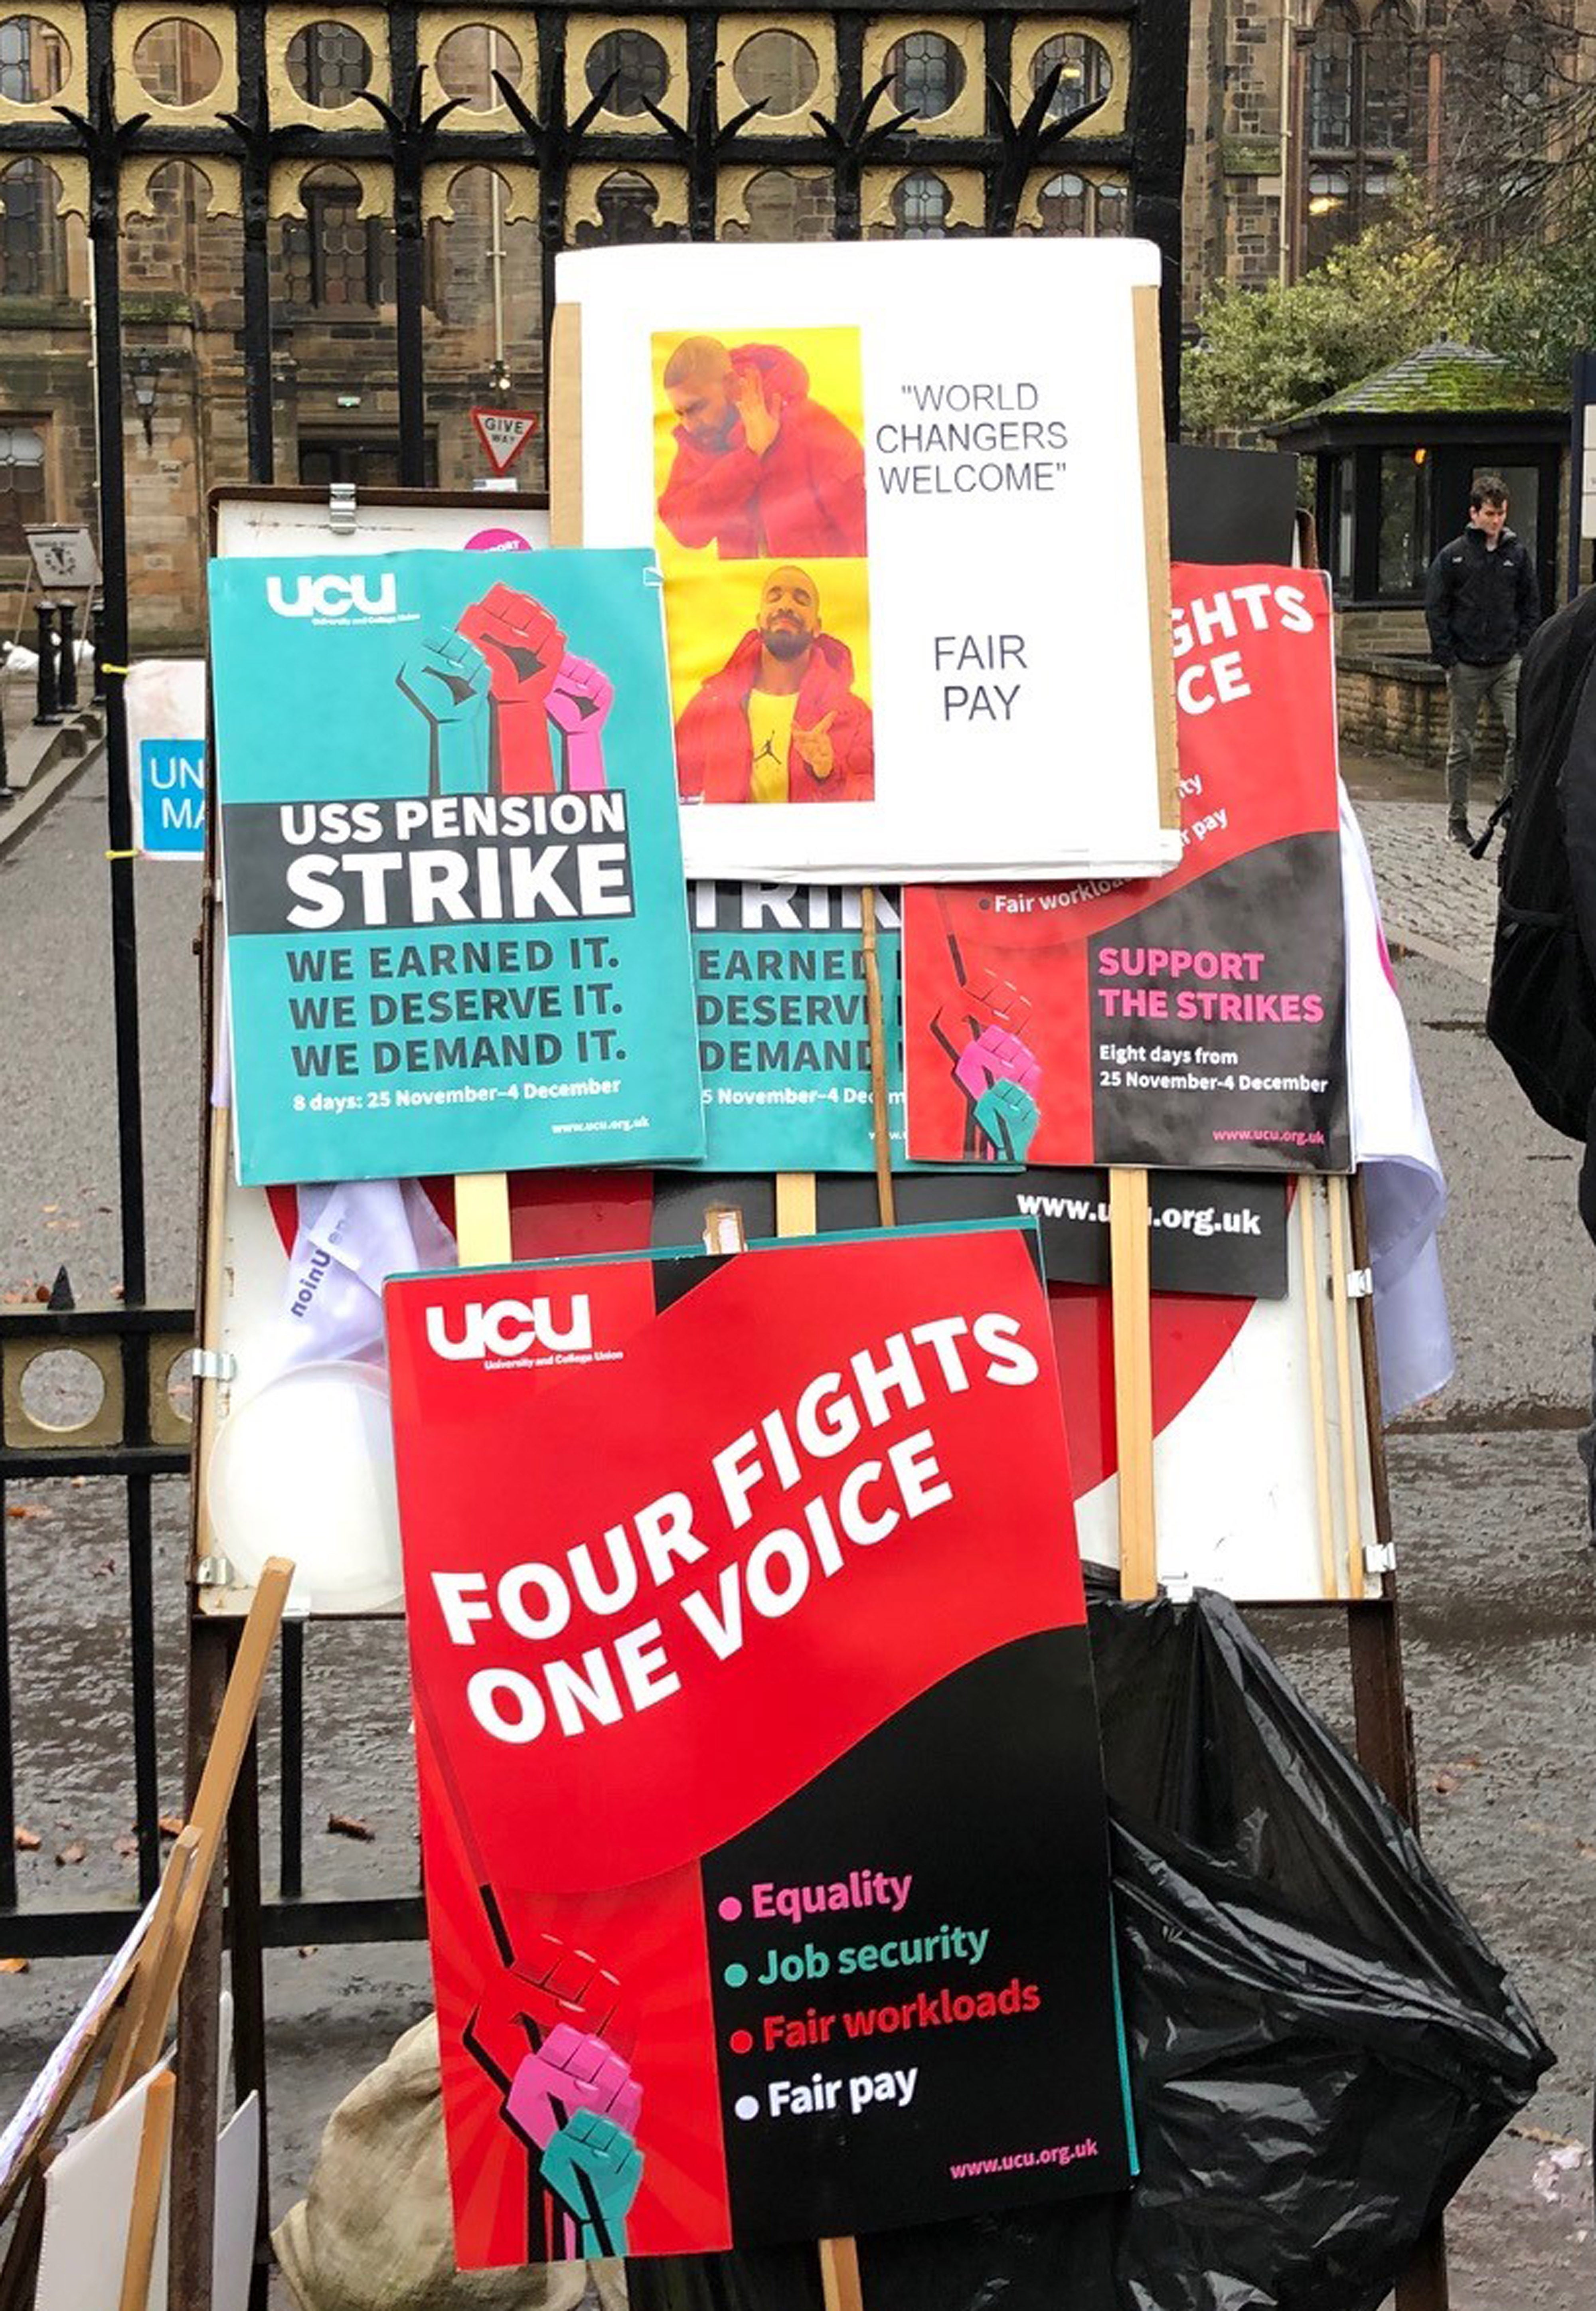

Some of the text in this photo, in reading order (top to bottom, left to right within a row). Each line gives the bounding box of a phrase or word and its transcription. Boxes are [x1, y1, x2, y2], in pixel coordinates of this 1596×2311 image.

[901, 382, 1038, 412] "WORLD
[485, 417, 524, 435] GIVE
[492, 434, 515, 442] WAY
[876, 422, 1068, 454] CHANGERS
[879, 462, 1067, 494] WELCOME"
[934, 634, 1028, 671] FAIR
[943, 685, 1020, 721] PAY
[280, 793, 625, 845] USS PENSION
[1192, 808, 1227, 840] pay
[286, 843, 632, 928] STRIKE
[995, 878, 1132, 913] Fair workloa
[286, 937, 618, 982] WE EARNED IT.
[1098, 948, 1264, 981] SUPPORT
[289, 983, 622, 1029] WE DESERVE IT.
[1098, 989, 1324, 1022] THE STRIKES
[291, 1029, 626, 1077] WE DEMAND IT.
[1100, 1045, 1238, 1066] Eight days from
[293, 1094, 304, 1111] 8
[309, 1092, 363, 1114] days:
[367, 1091, 390, 1108] 25
[524, 1078, 621, 1099] December
[1100, 1071, 1121, 1086] 25
[1239, 1075, 1328, 1093] December
[1213, 1128, 1324, 1146] www.ucu.org.uk
[1017, 1194, 1260, 1236] www.u.org.uk
[431, 1311, 1039, 1645] FOUR FIGHTS
[466, 1428, 953, 1744] ONE VOICE
[752, 1870, 912, 1923] Equality
[758, 1924, 990, 1986] Job security
[764, 1977, 1041, 2052] Fair workloads
[768, 2066, 918, 2118] Fair pay
[949, 2137, 1097, 2180] www.ucu.org.uk
